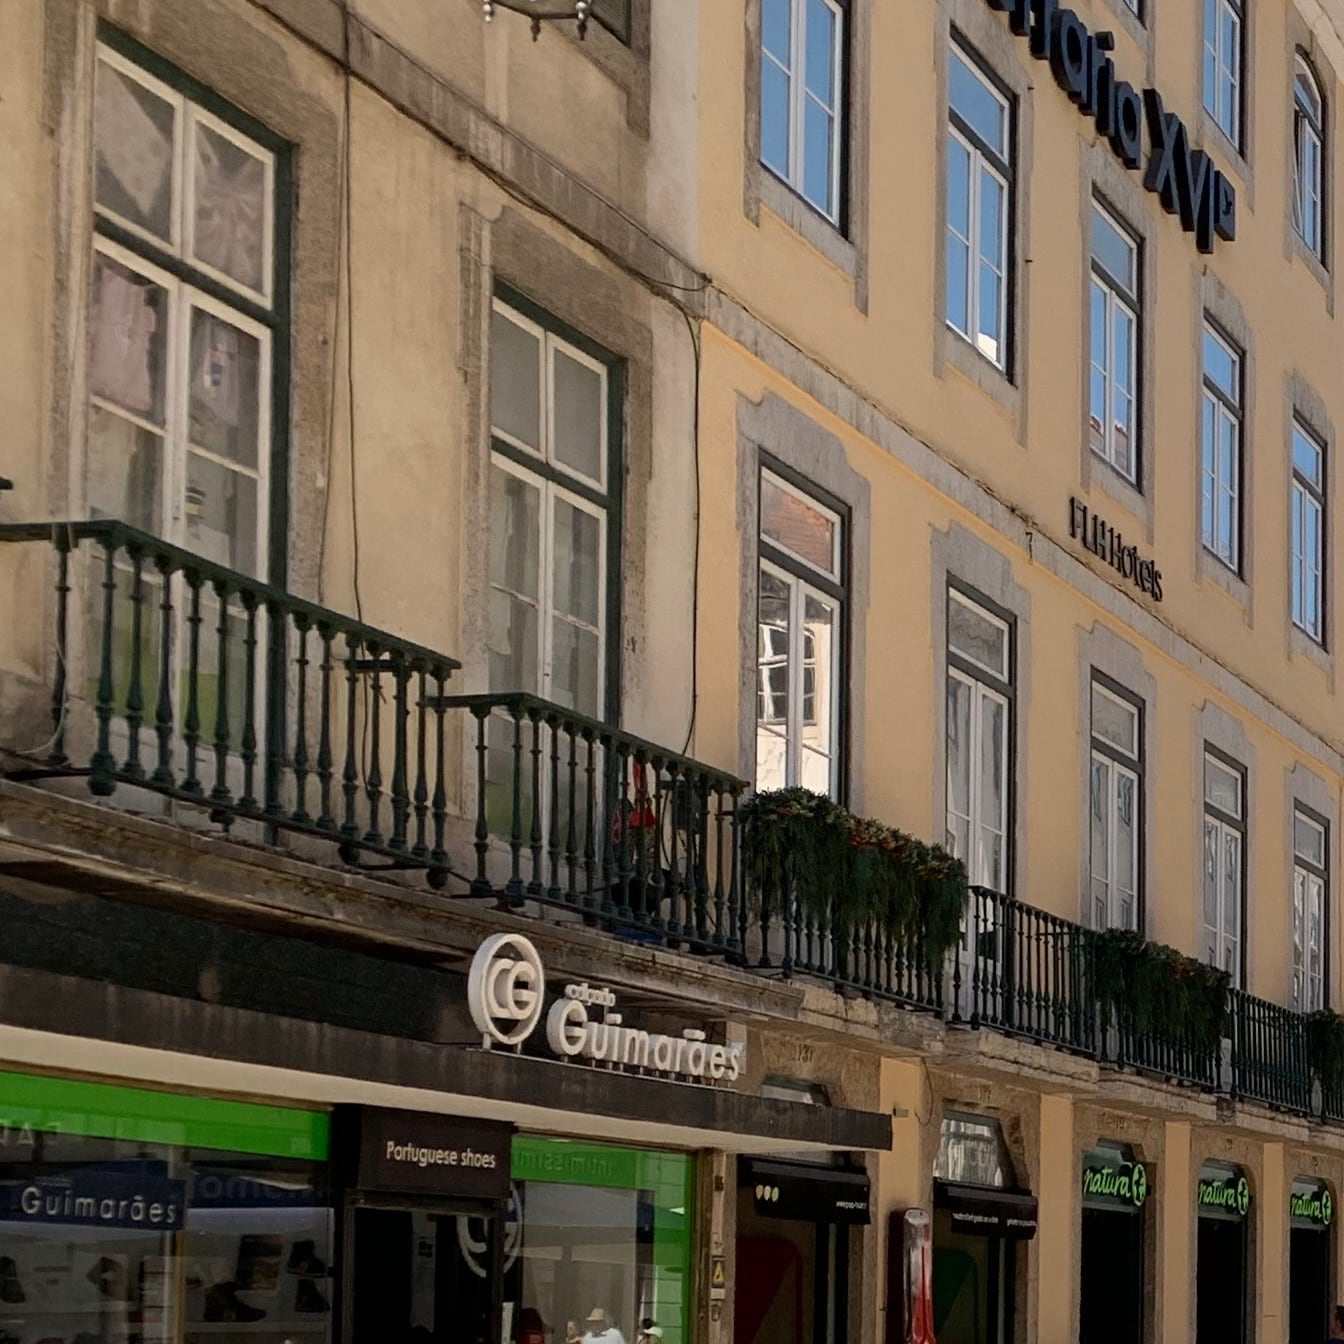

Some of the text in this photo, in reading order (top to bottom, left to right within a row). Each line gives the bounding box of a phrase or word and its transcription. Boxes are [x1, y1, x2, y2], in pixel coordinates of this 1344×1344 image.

[1107, 527, 1163, 602] Hotels
[546, 998, 741, 1082] Guimarães
[386, 1140, 496, 1169] Portuguese shoes
[1084, 1167, 1131, 1198] natura
[1199, 1177, 1236, 1207] natura
[20, 1186, 178, 1225] Guimarães
[1291, 1193, 1322, 1219] natura
